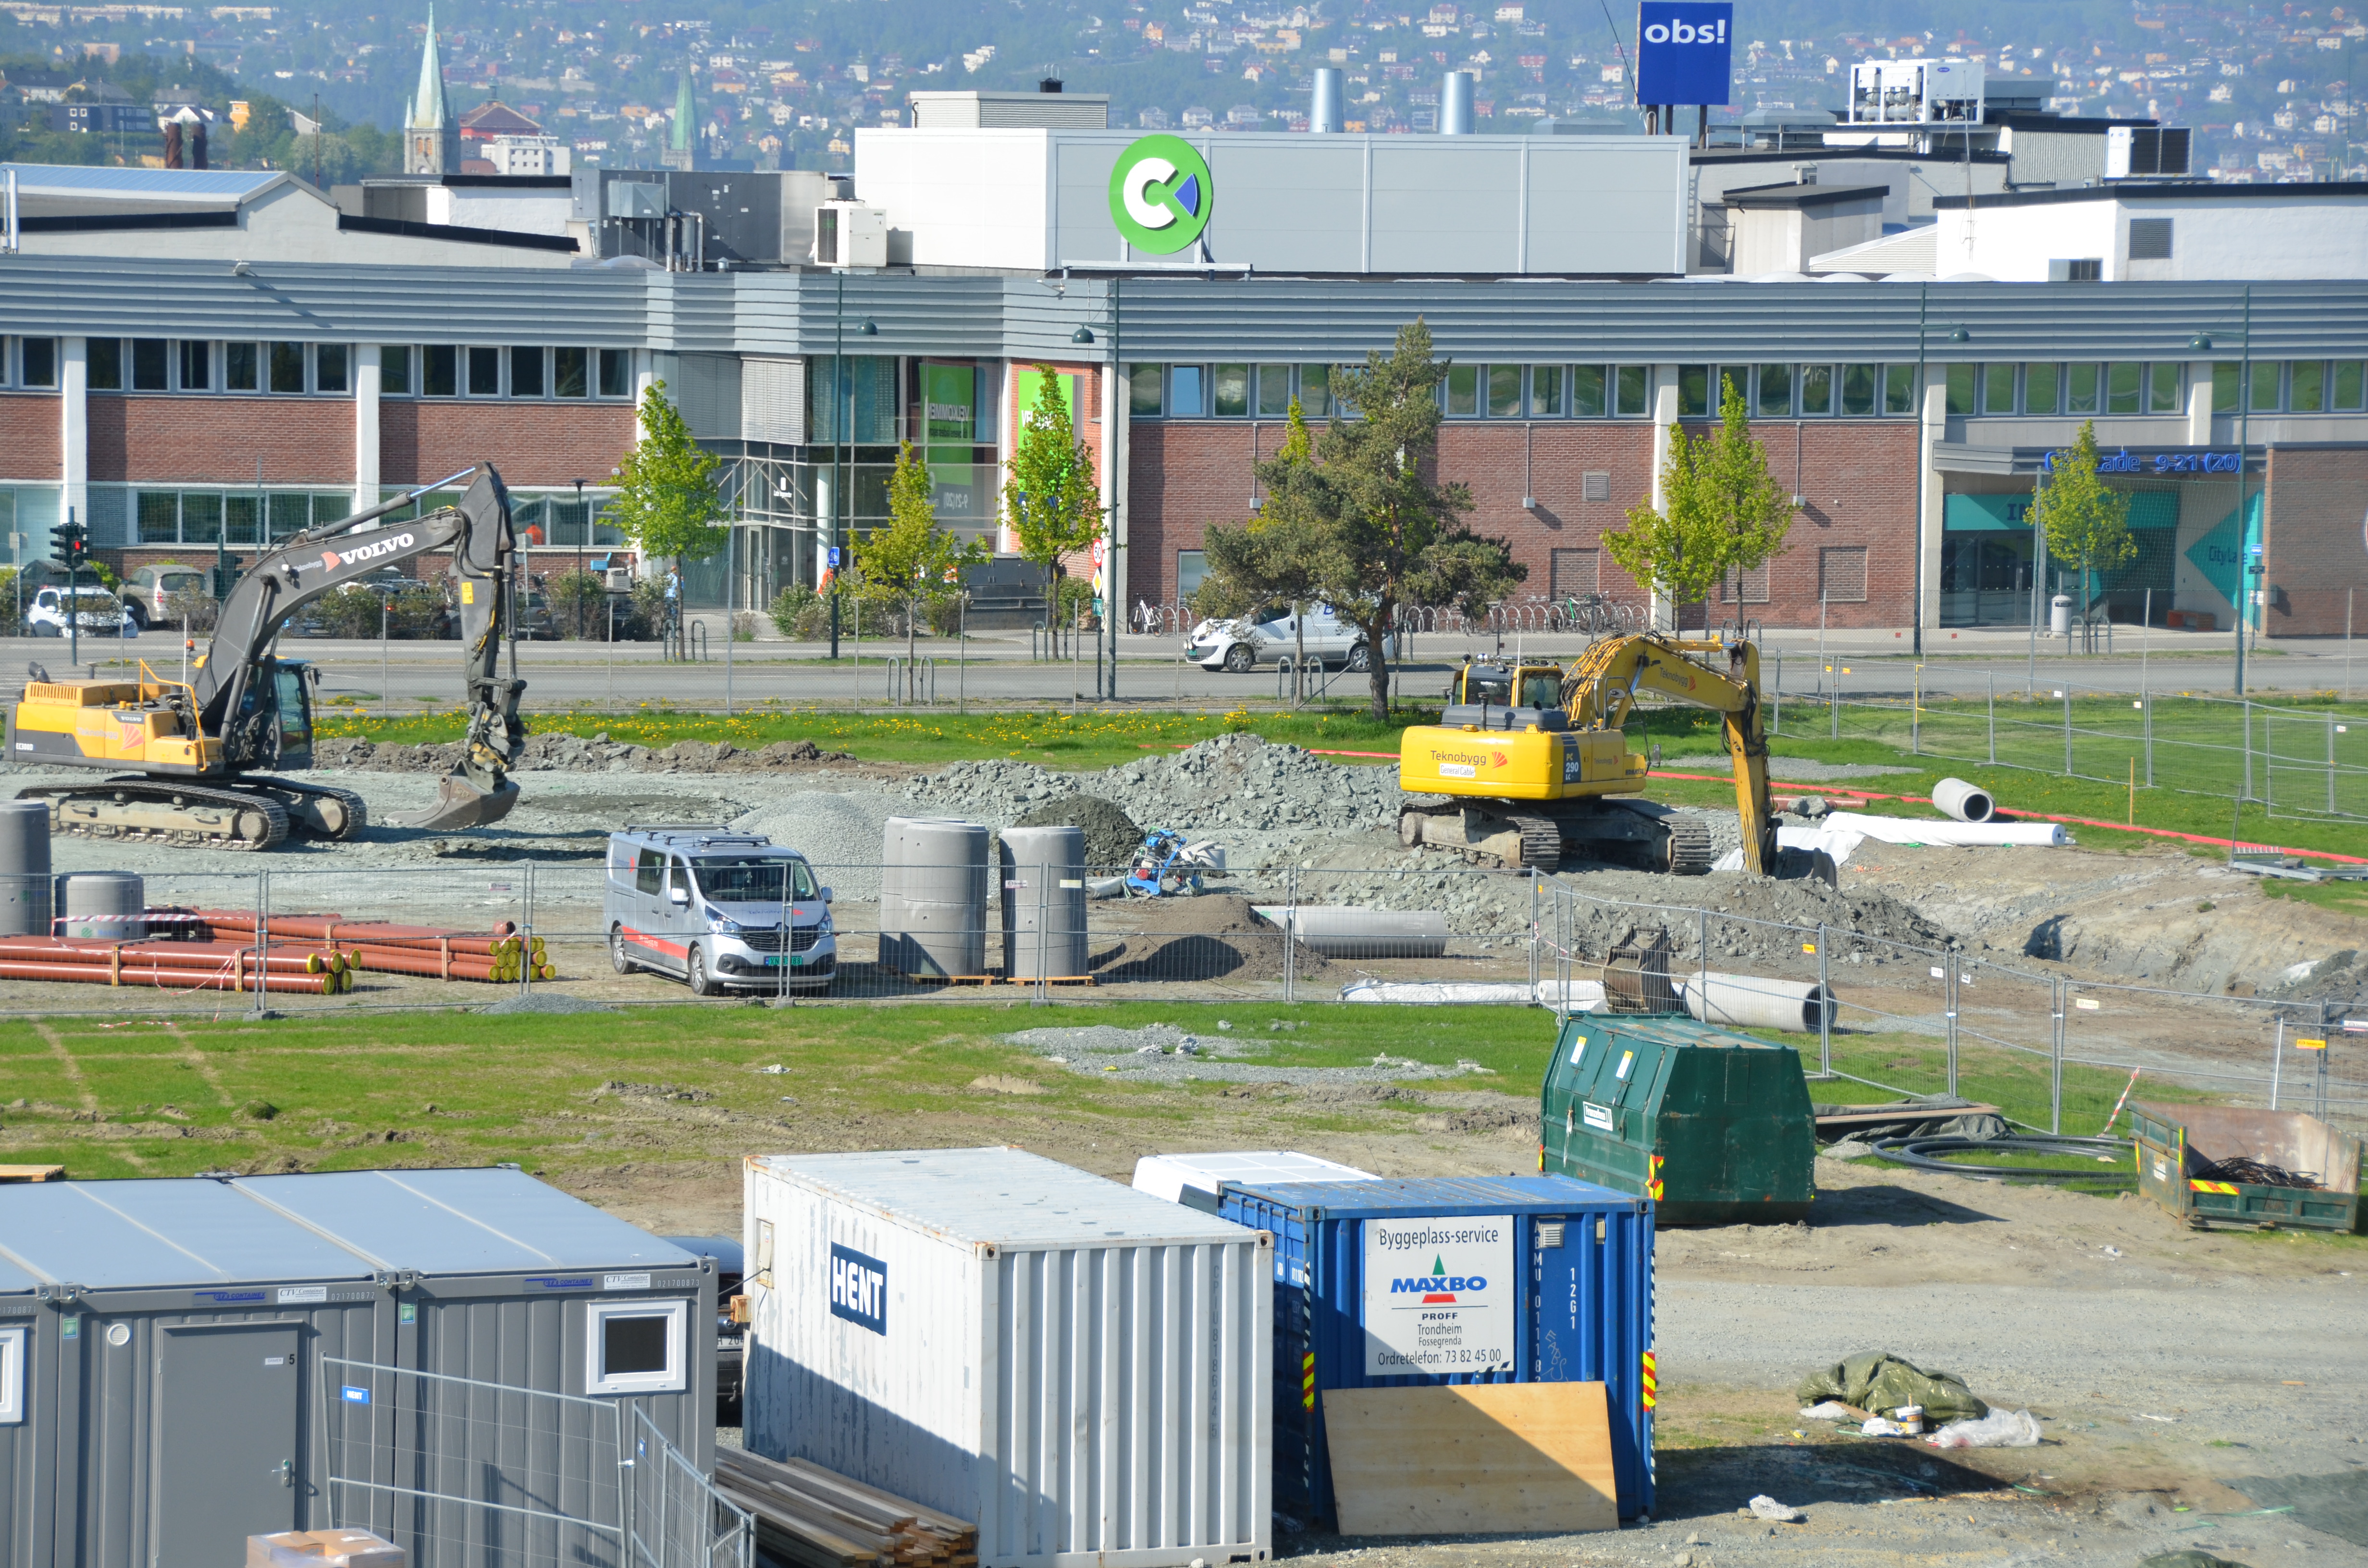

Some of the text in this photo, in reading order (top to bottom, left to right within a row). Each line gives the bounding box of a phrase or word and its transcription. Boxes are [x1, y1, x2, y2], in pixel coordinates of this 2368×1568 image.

[1645, 19, 1726, 43] obs!
[2156, 454, 2197, 472] 9-21
[339, 533, 414, 564] VOLVO
[1095, 547, 1101, 559] 50
[2229, 547, 2248, 564] Lae
[1660, 667, 1688, 687] Teknobygg
[77, 727, 118, 740] Teknobygg
[1431, 750, 1486, 766] Teknobygg
[1441, 765, 1474, 776] General Cable
[1566, 762, 1579, 772] 290
[1380, 1225, 1498, 1250] Byggeplass-service
[657, 1279, 699, 1287] 021700873
[833, 1256, 883, 1320] HENT
[1391, 1276, 1487, 1293] MAXBO
[331, 1292, 375, 1300] 021700872
[1418, 1323, 1462, 1335] Trondheim
[1419, 1335, 1462, 1348] Fossegrenda
[289, 1354, 295, 1365] 5
[1378, 1348, 1501, 1365] Ordretelefon: 73 82 45 00
[347, 1390, 362, 1400] HENT
